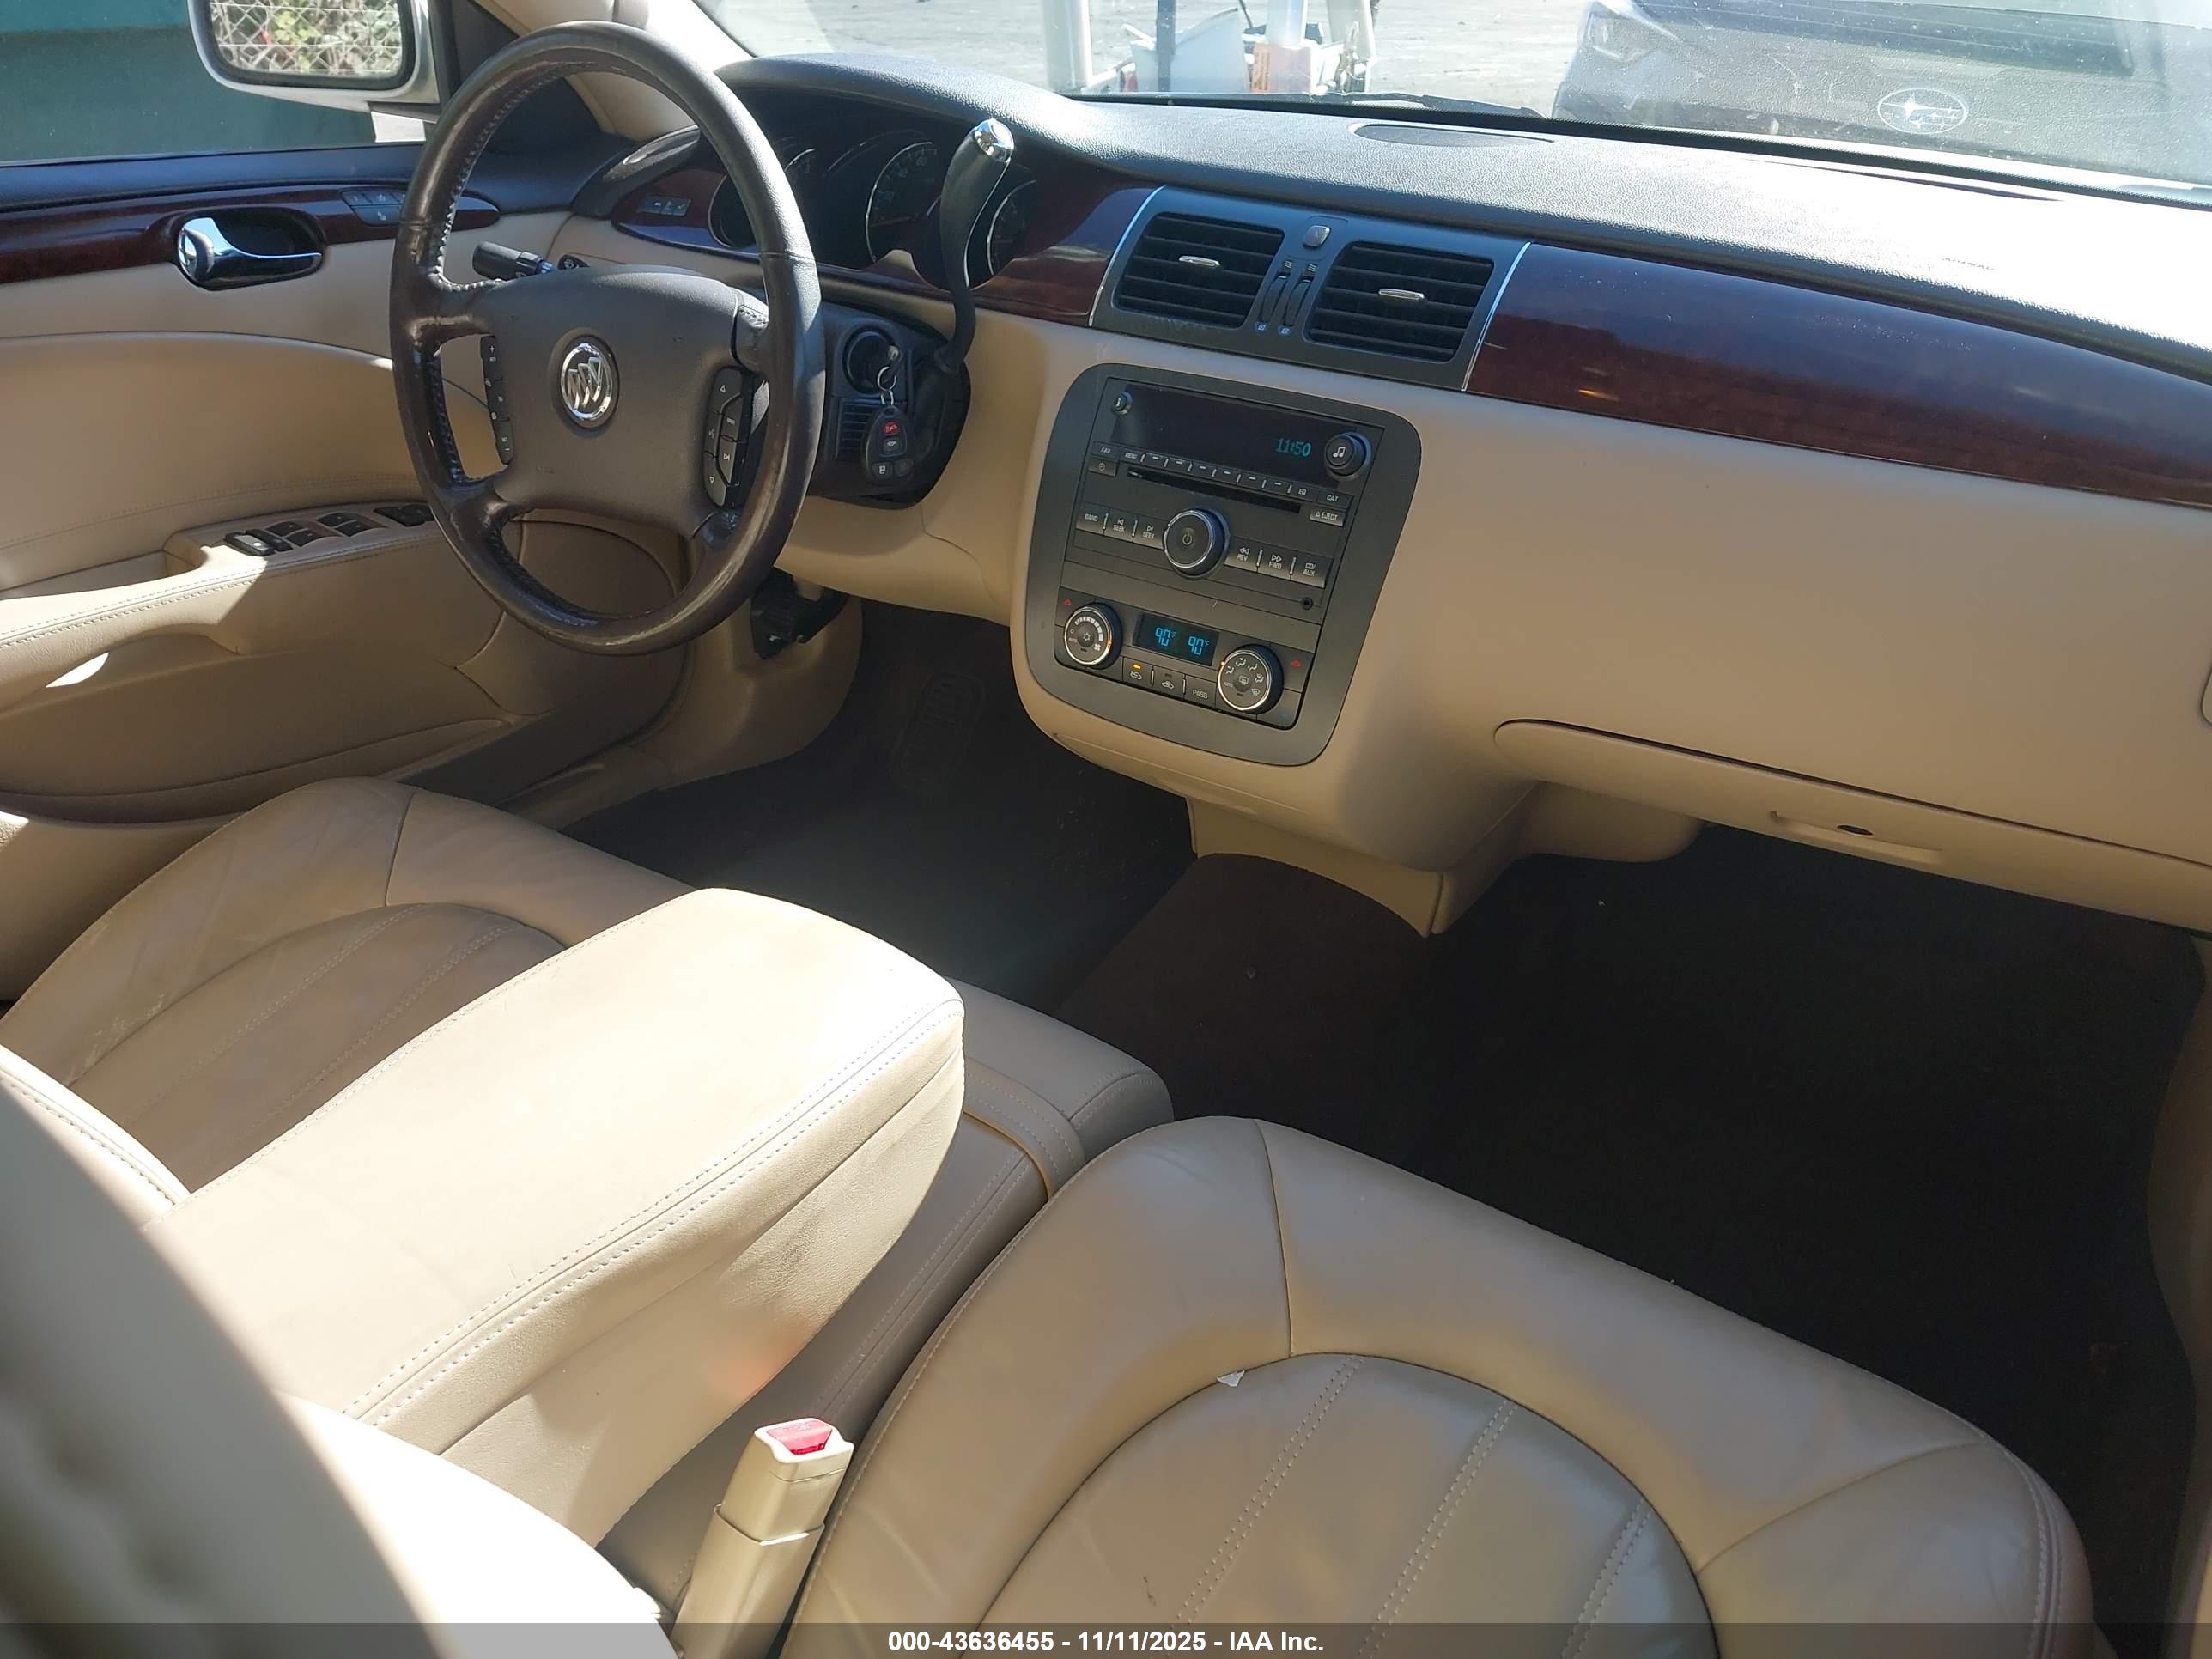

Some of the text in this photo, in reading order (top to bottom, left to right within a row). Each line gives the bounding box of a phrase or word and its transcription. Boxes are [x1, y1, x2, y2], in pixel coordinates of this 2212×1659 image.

[1276, 438, 1311, 456] 11:50
[1321, 511, 1338, 521] EJECT
[1268, 561, 1282, 569] FWD
